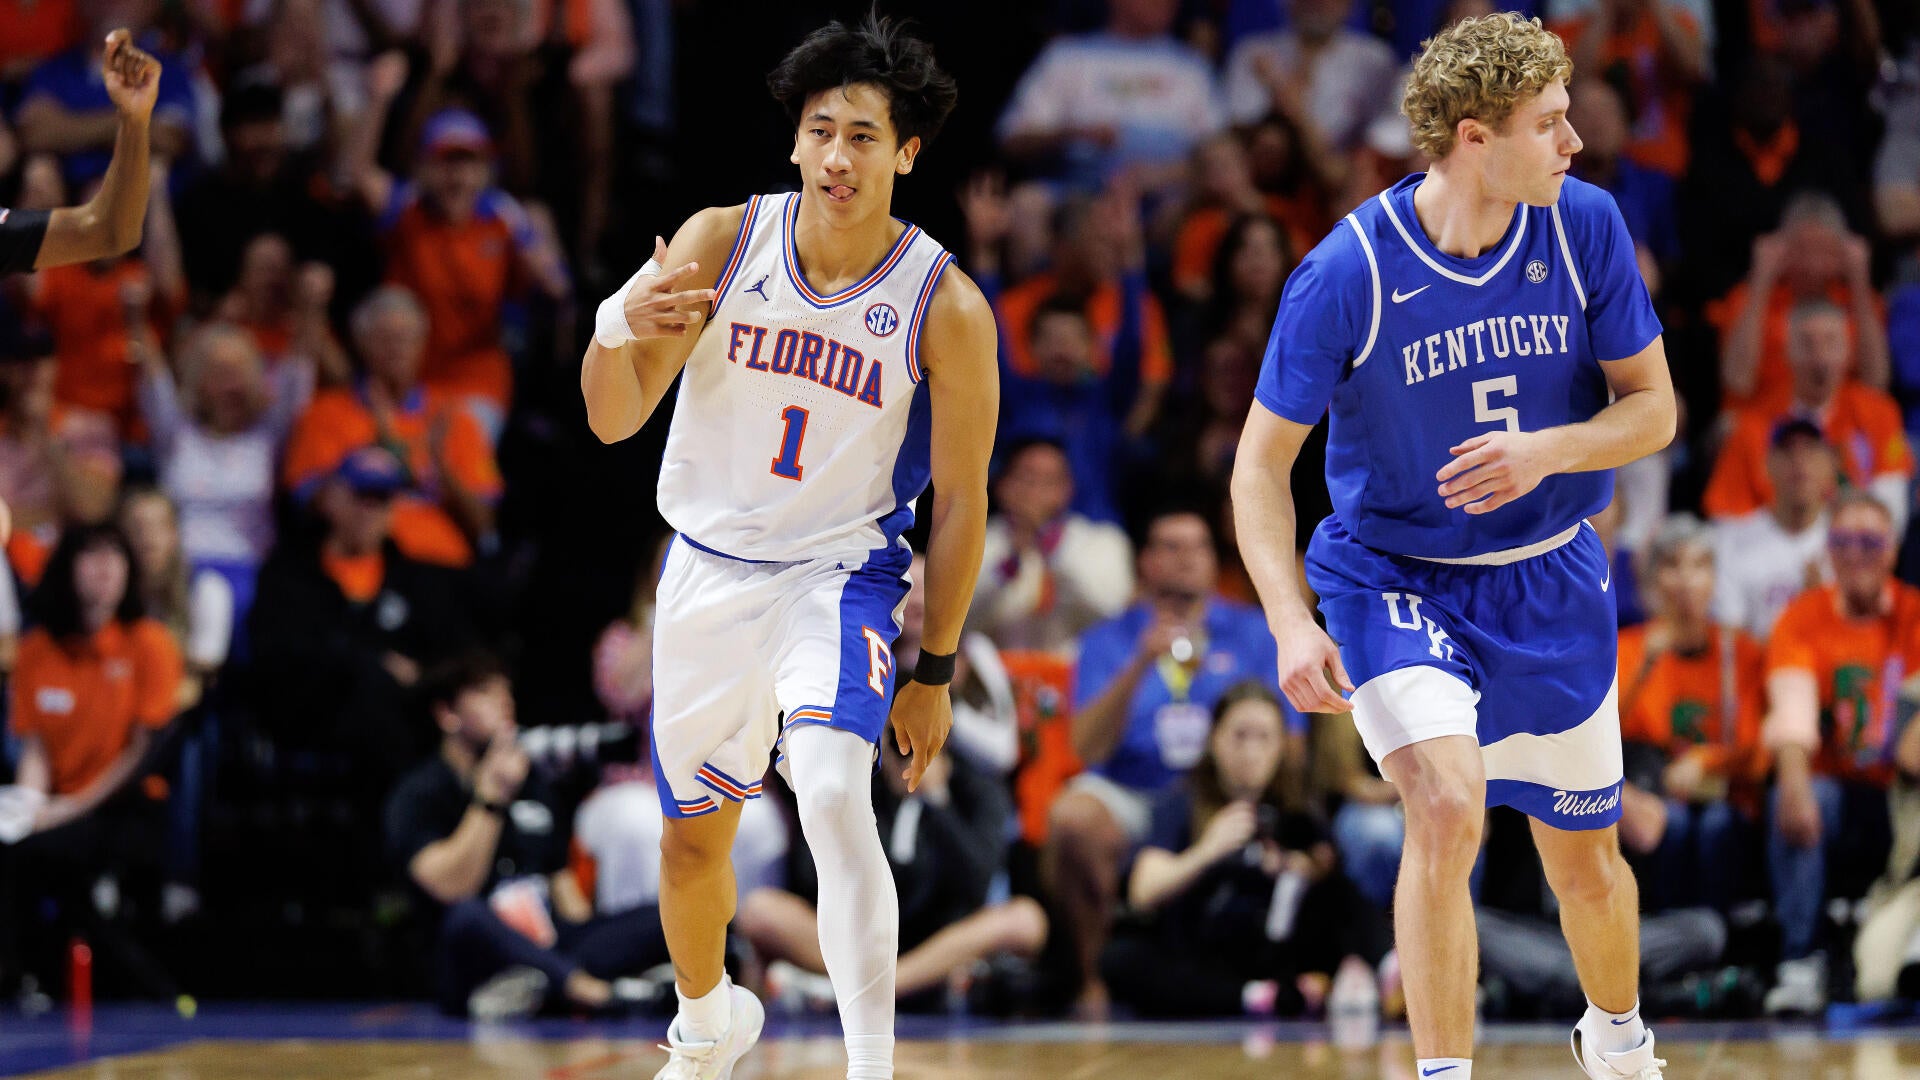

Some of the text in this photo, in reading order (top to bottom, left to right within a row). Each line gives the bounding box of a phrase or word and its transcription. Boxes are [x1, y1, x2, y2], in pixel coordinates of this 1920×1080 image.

[1527, 261, 1547, 282] SEC
[867, 304, 898, 336] SEC
[1403, 315, 1569, 386] KENTUCKY
[728, 322, 883, 409] FLORIDA
[1471, 374, 1520, 432] 5
[770, 404, 810, 482] 1
[862, 624, 893, 700] F
